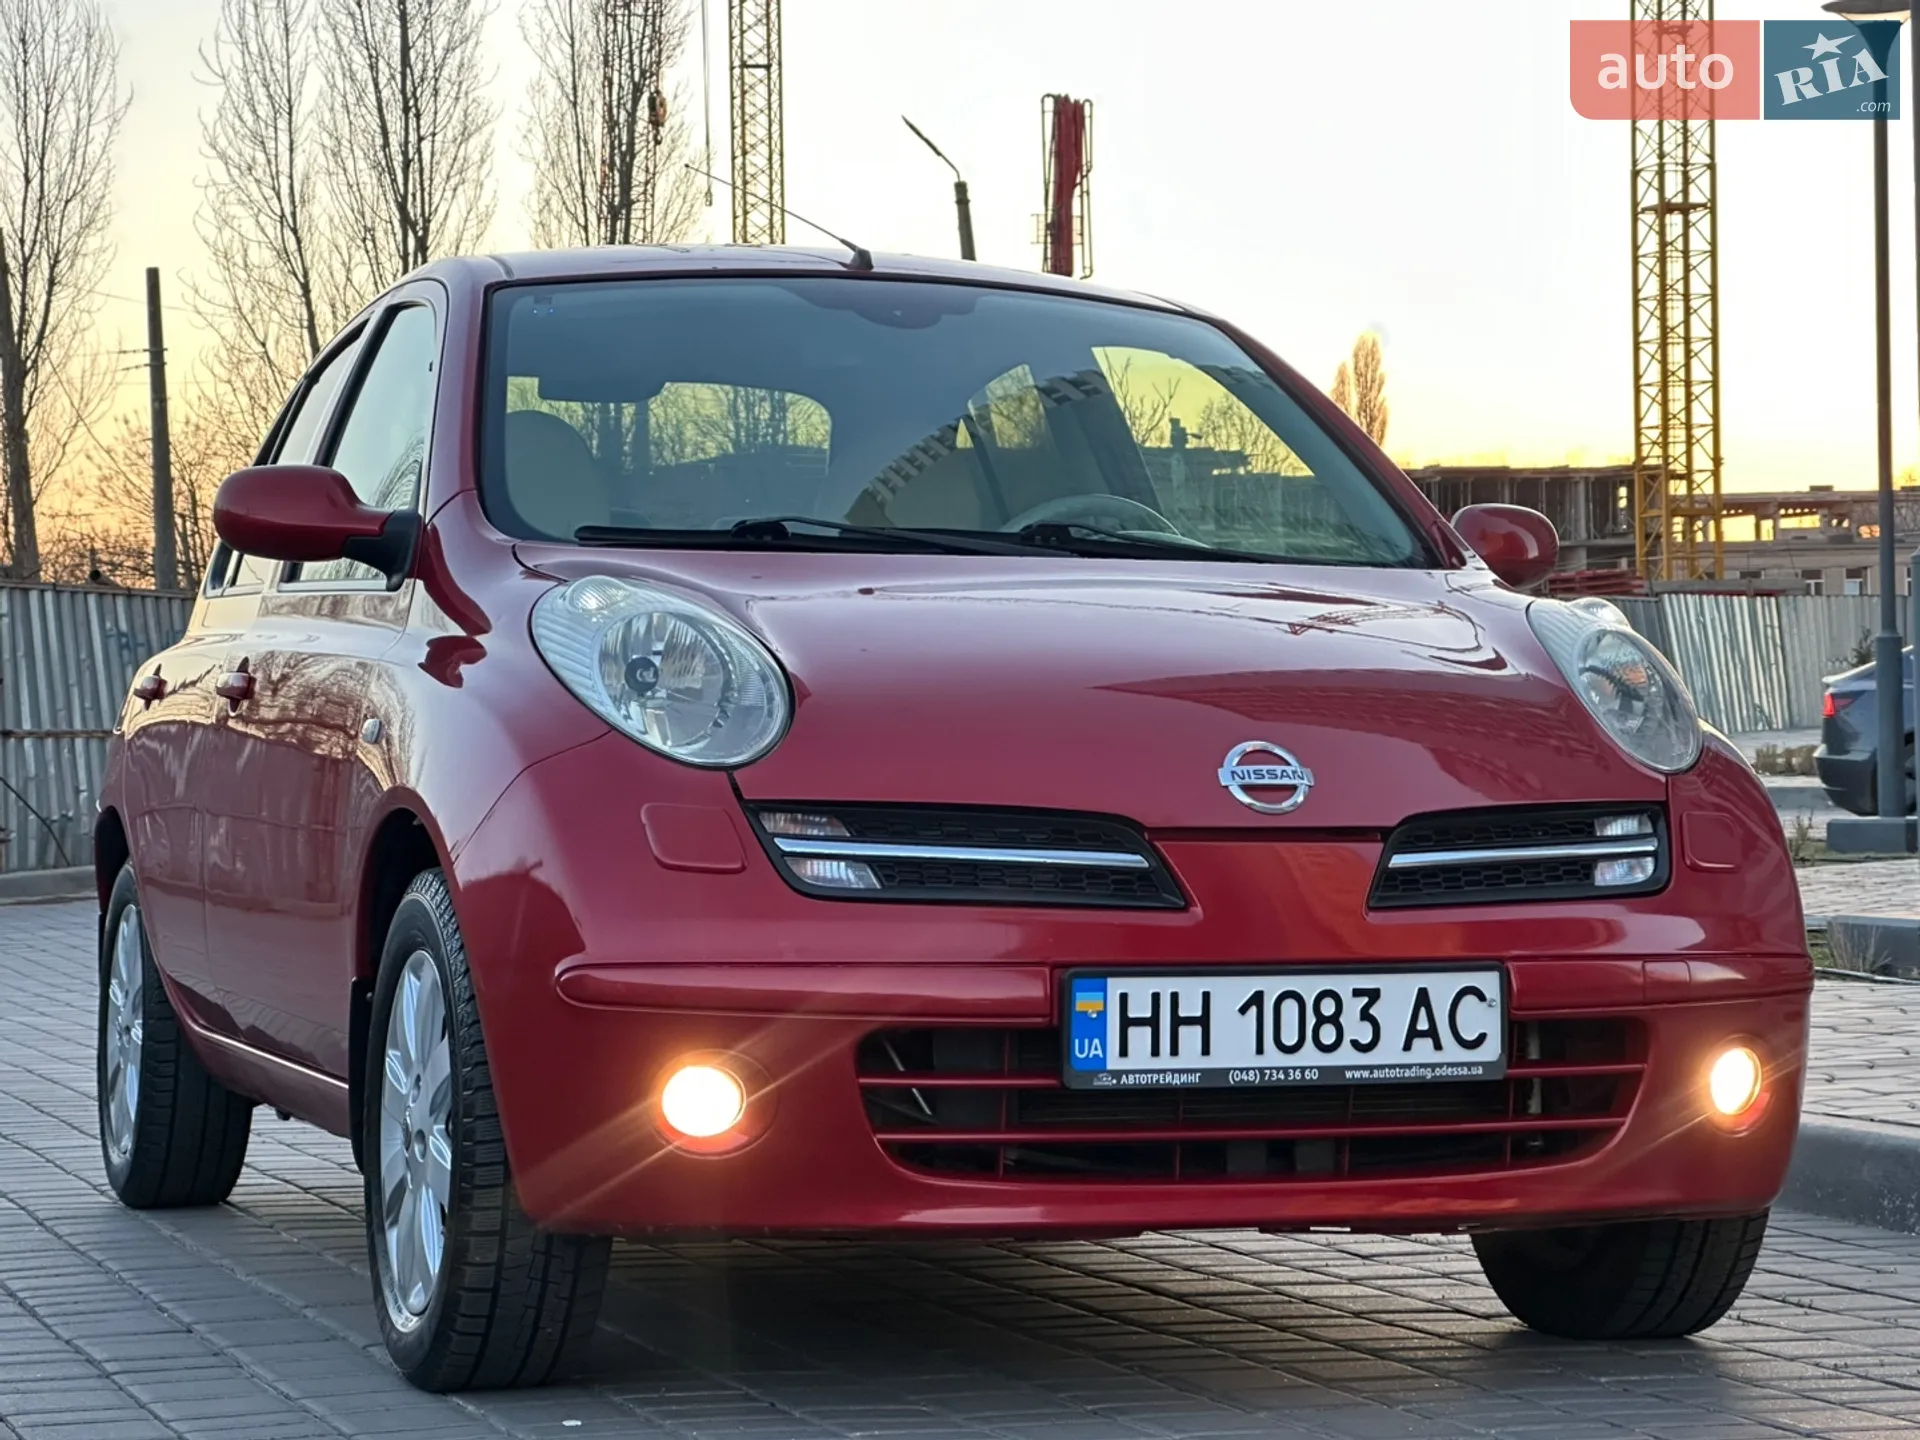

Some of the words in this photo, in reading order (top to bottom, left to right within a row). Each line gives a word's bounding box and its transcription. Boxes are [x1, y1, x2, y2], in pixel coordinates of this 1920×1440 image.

[1230, 769, 1305, 781] NISSAN
[1237, 987, 1382, 1055] 1083
[1402, 985, 1488, 1052] AC
[1074, 1038, 1104, 1059] UA
[1120, 1072, 1201, 1085] АВТОТРЕЙДИНГ
[1228, 1069, 1260, 1084] (048)
[1264, 1069, 1285, 1081] 734
[1288, 1069, 1301, 1080] 36
[1304, 1068, 1319, 1080] 60
[1345, 1065, 1483, 1079] www.autotrading.odessa.ua
